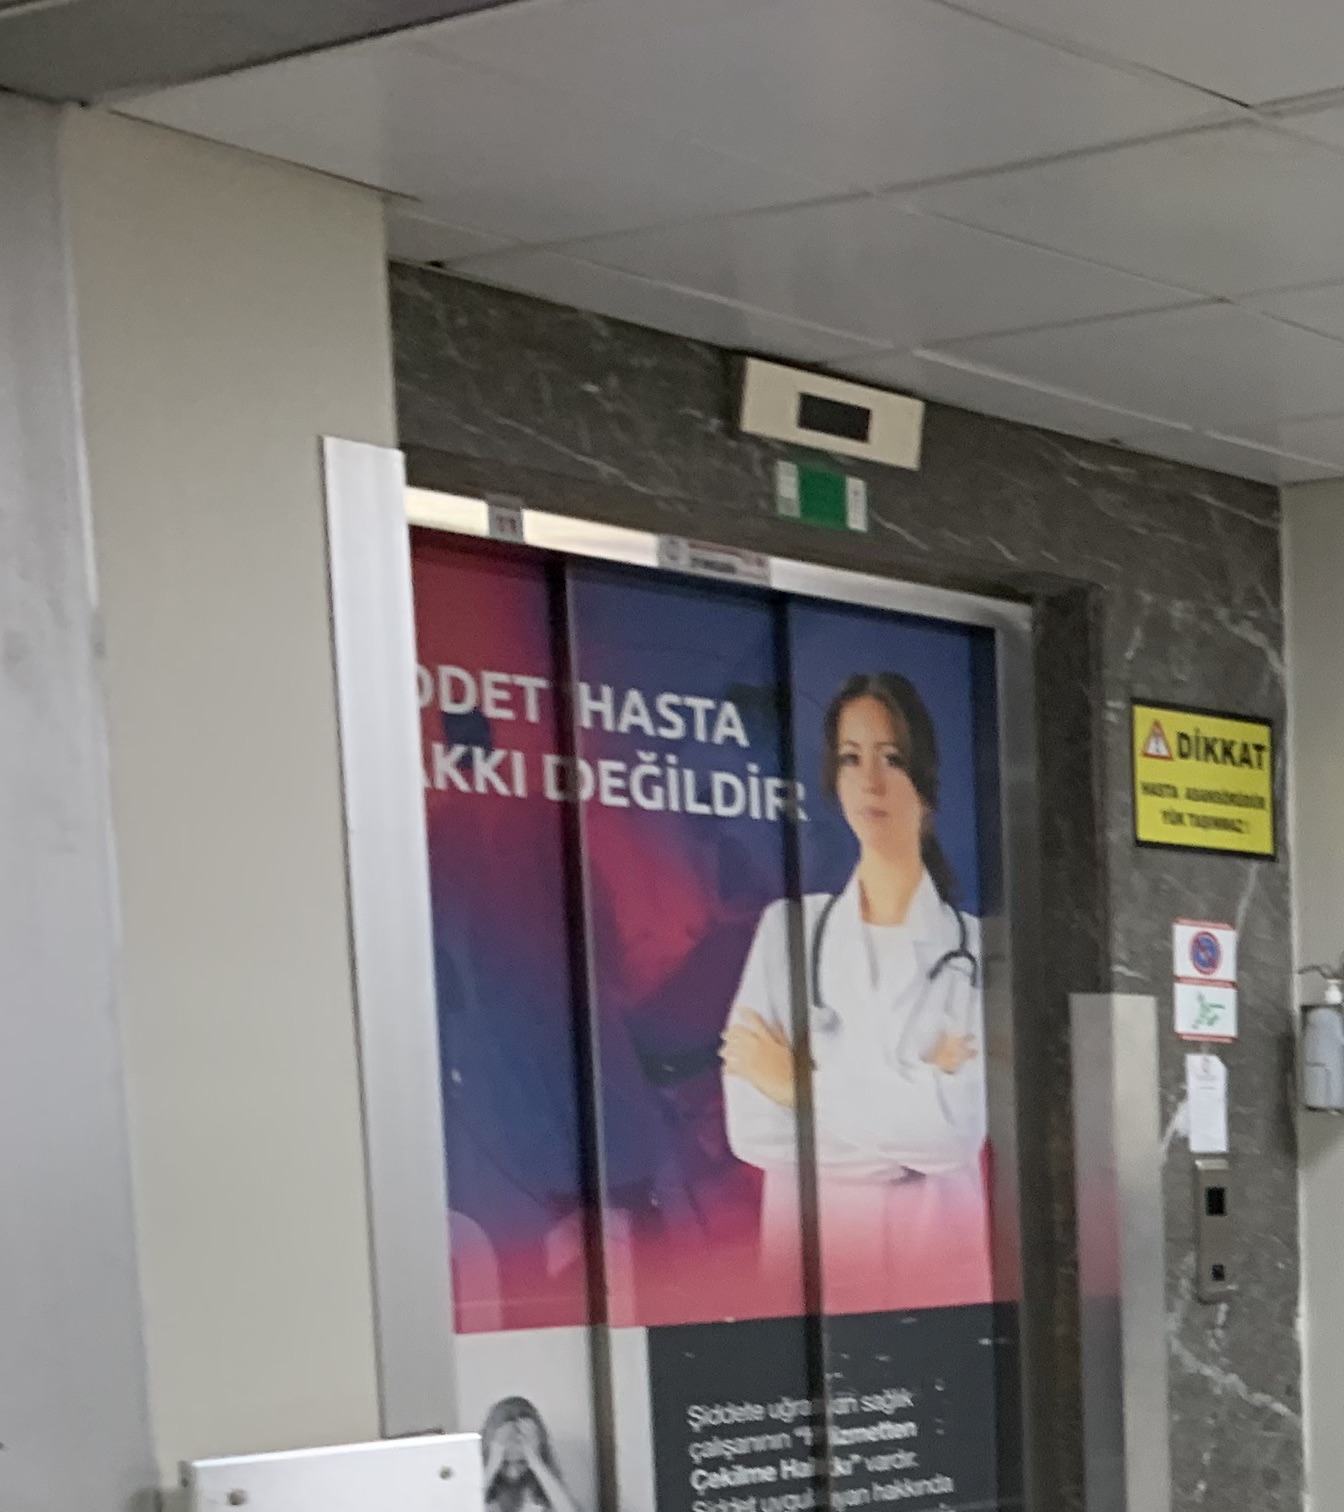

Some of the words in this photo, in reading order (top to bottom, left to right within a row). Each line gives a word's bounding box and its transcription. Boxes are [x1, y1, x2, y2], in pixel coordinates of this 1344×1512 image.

[578, 682, 750, 748] HASTA
[1177, 727, 1266, 770] DİKKAT
[542, 751, 810, 822] DEĞİLDİR
